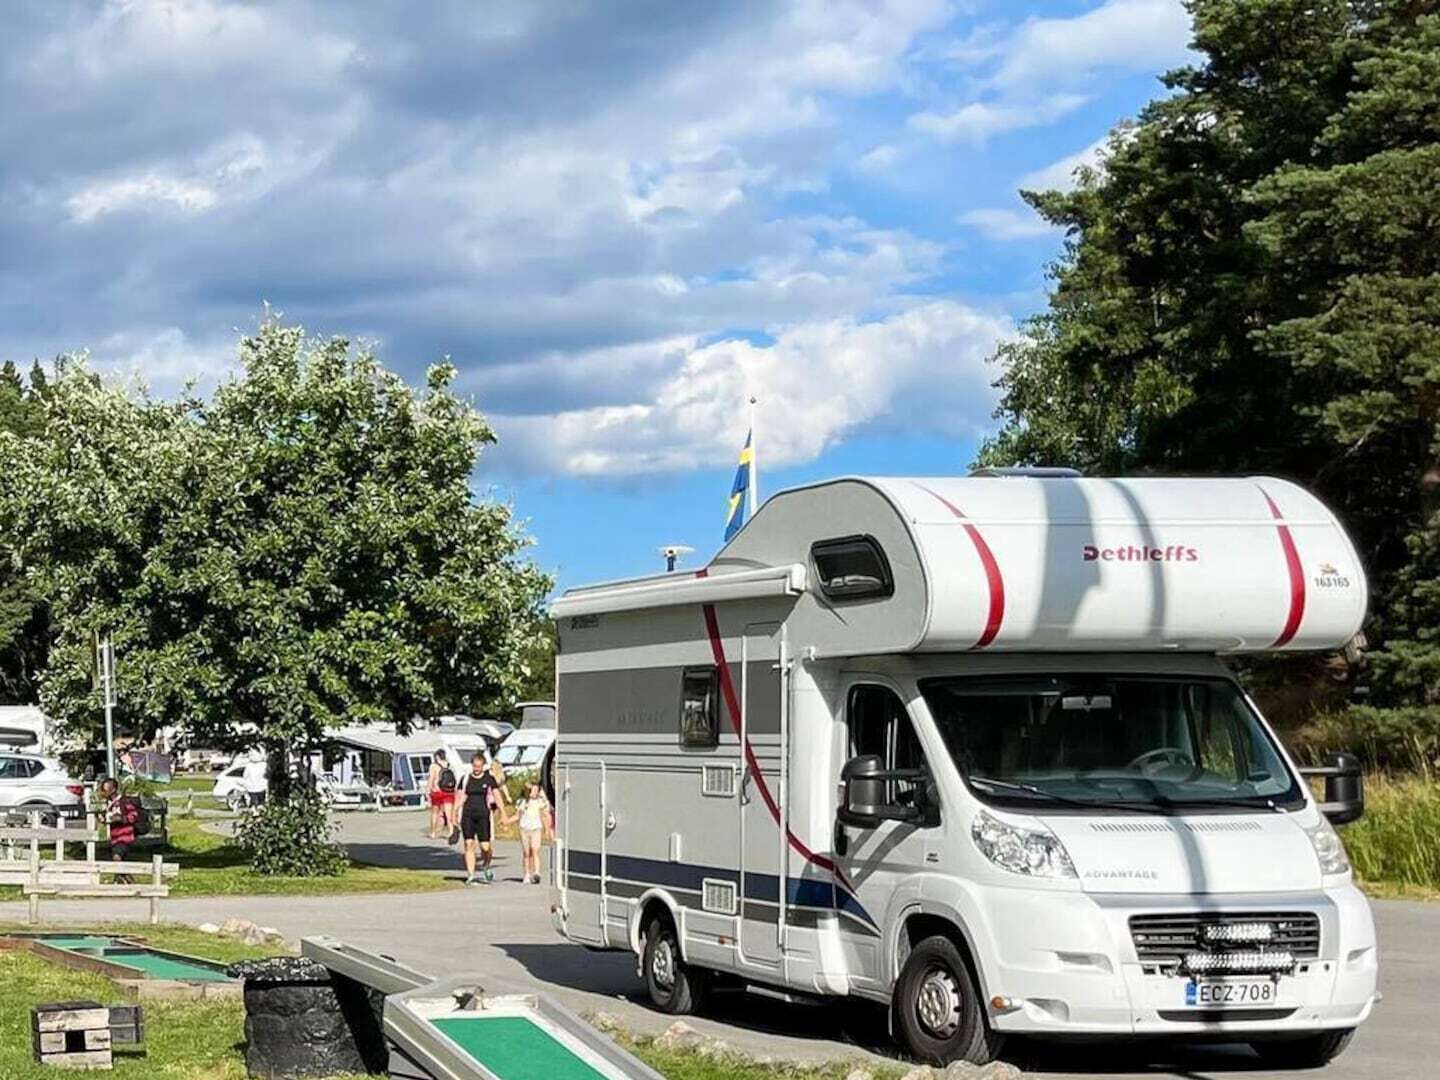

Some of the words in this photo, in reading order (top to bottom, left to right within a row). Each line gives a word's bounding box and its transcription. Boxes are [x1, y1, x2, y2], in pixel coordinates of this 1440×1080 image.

[1083, 545, 1199, 561] Dethleffs
[1083, 870, 1159, 880] ADVANTAGE
[1200, 984, 1271, 1001] ECZ-708
